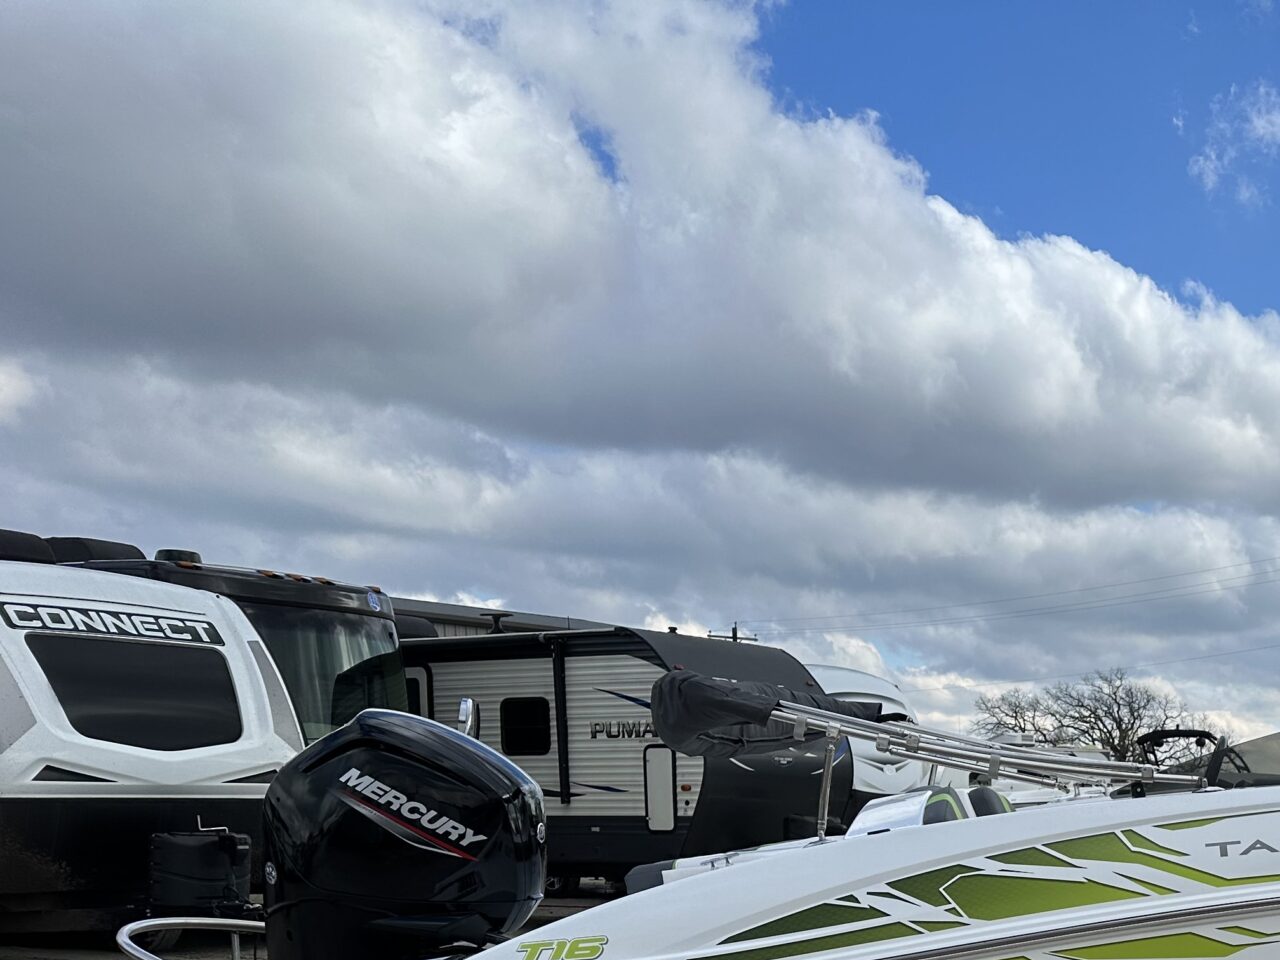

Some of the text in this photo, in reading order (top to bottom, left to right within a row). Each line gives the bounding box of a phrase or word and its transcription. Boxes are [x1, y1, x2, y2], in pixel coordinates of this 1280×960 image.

[3, 604, 213, 643] CONNECT
[589, 721, 659, 739] PUMA
[339, 767, 488, 847] MERCURY
